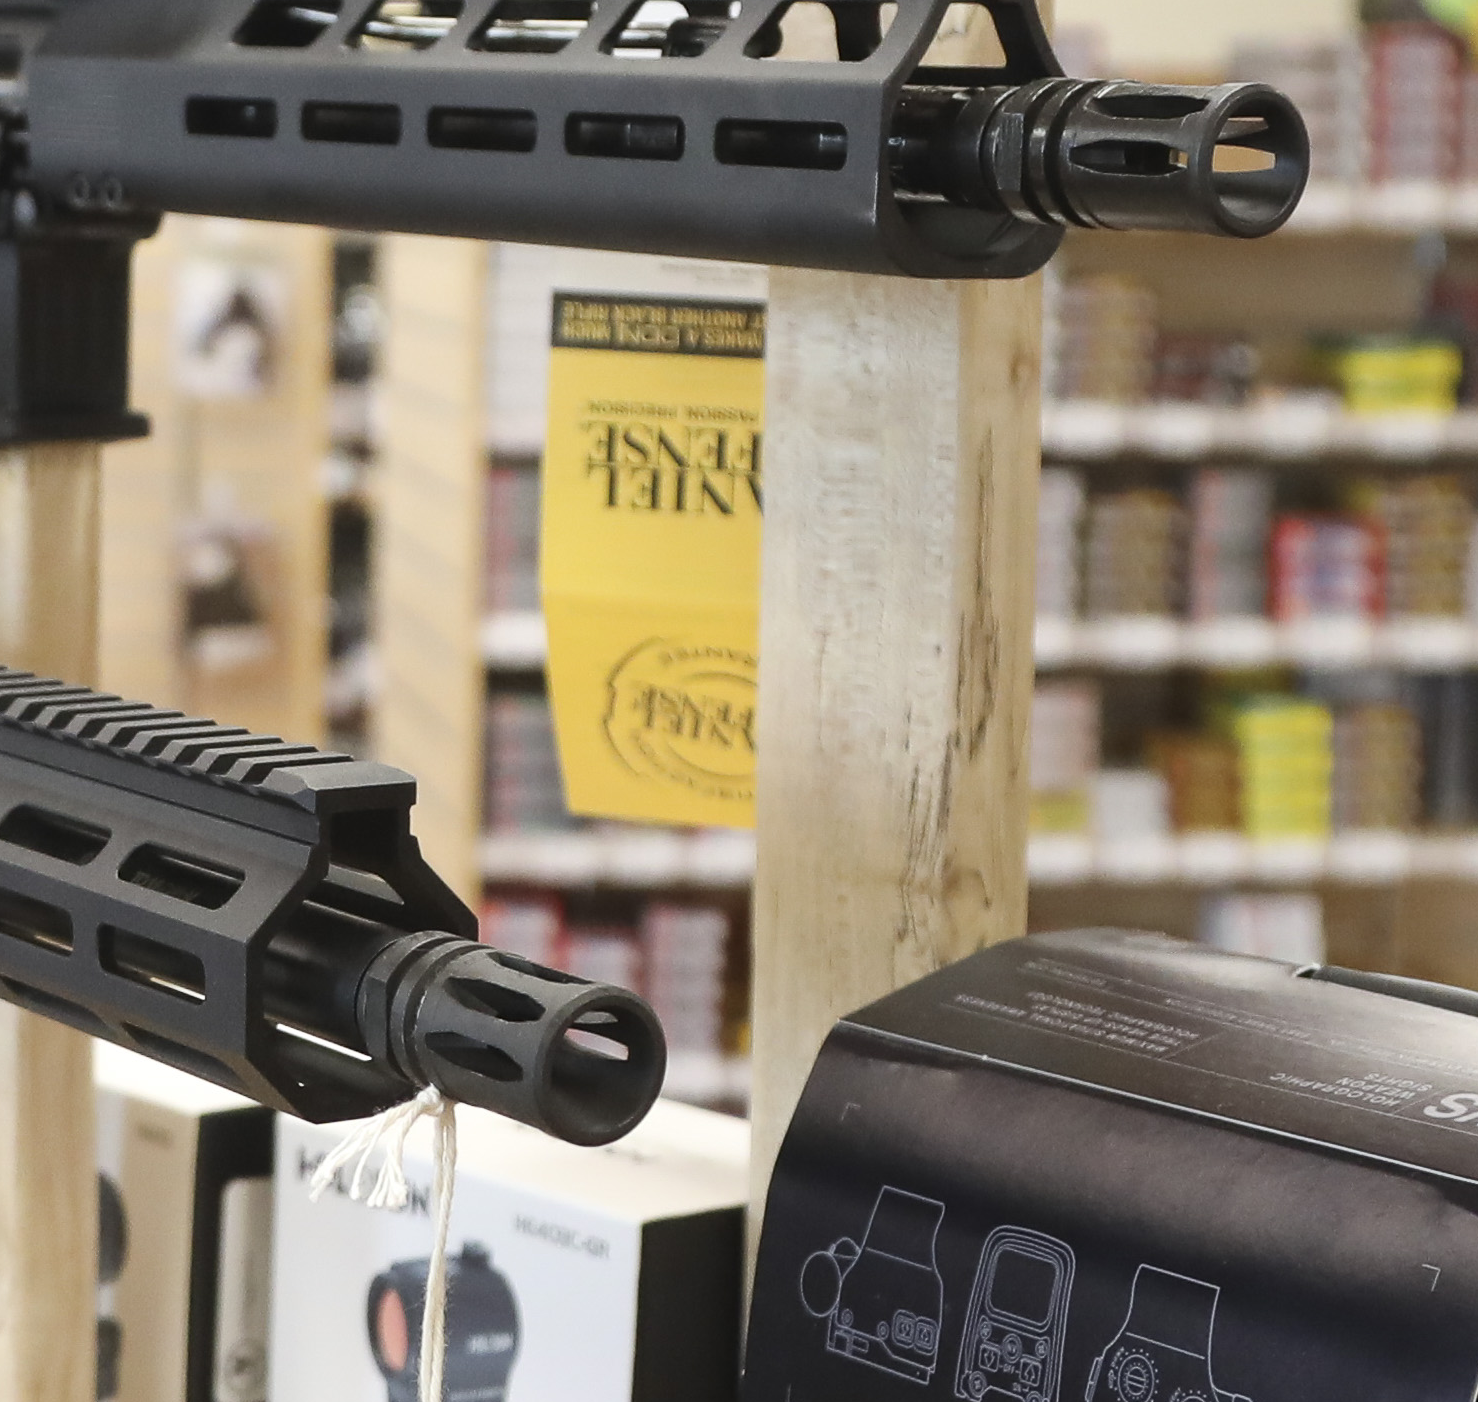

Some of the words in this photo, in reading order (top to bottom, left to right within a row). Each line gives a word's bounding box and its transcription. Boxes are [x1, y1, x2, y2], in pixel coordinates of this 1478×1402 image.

[1270, 1072, 1401, 1107] HOLOGRAPHIC
[1338, 1076, 1417, 1100] WEAPON
[1363, 1071, 1433, 1092] SIGHTS
